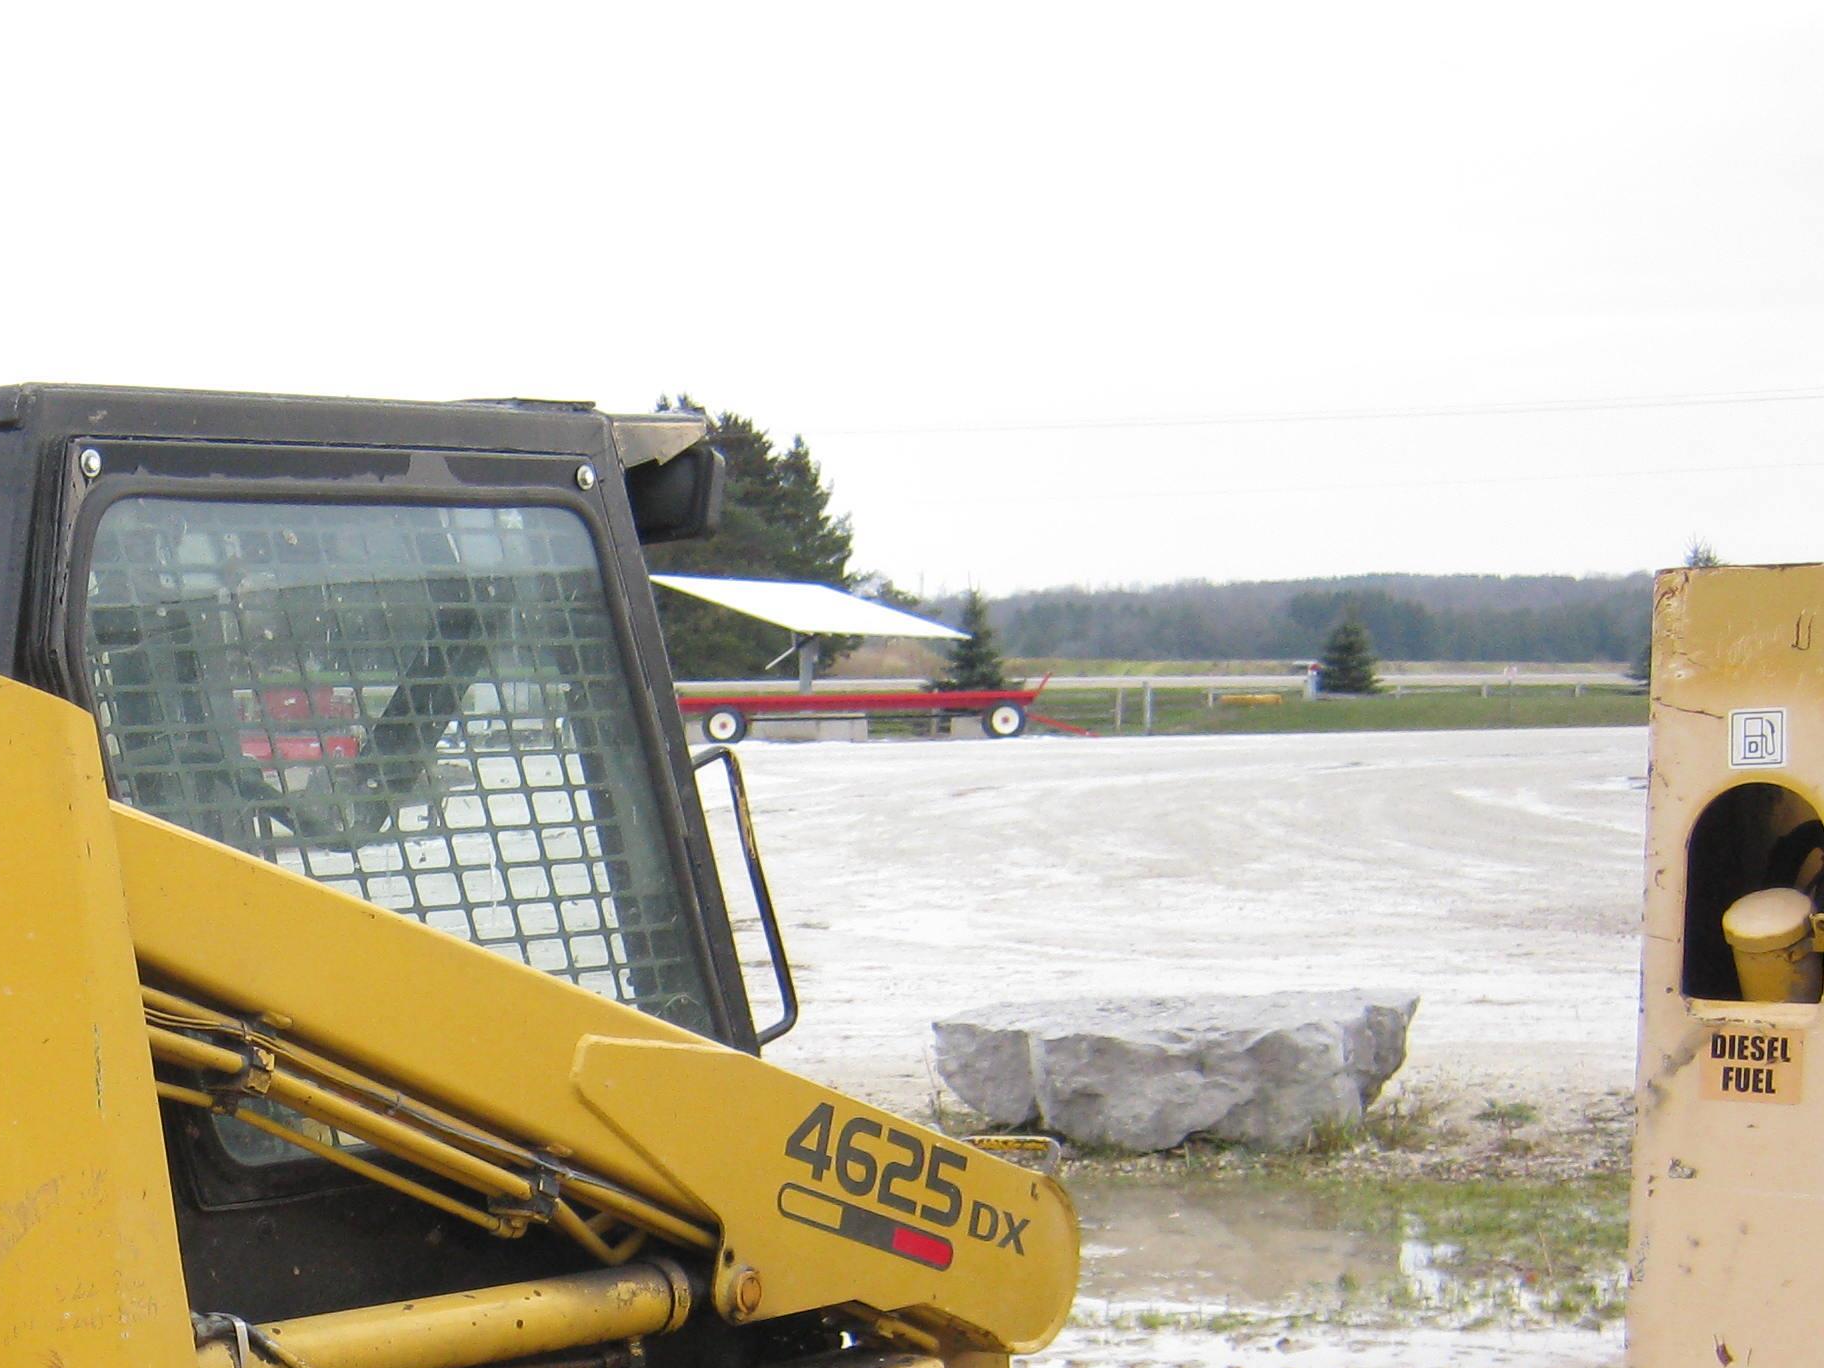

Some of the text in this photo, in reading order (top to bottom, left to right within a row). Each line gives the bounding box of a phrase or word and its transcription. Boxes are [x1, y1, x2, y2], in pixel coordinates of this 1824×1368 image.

[1748, 741, 1759, 754] D
[1711, 1033, 1791, 1062] DIESEL
[1722, 1066, 1776, 1094] FUEL
[784, 1102, 1031, 1256] 4625 DX
